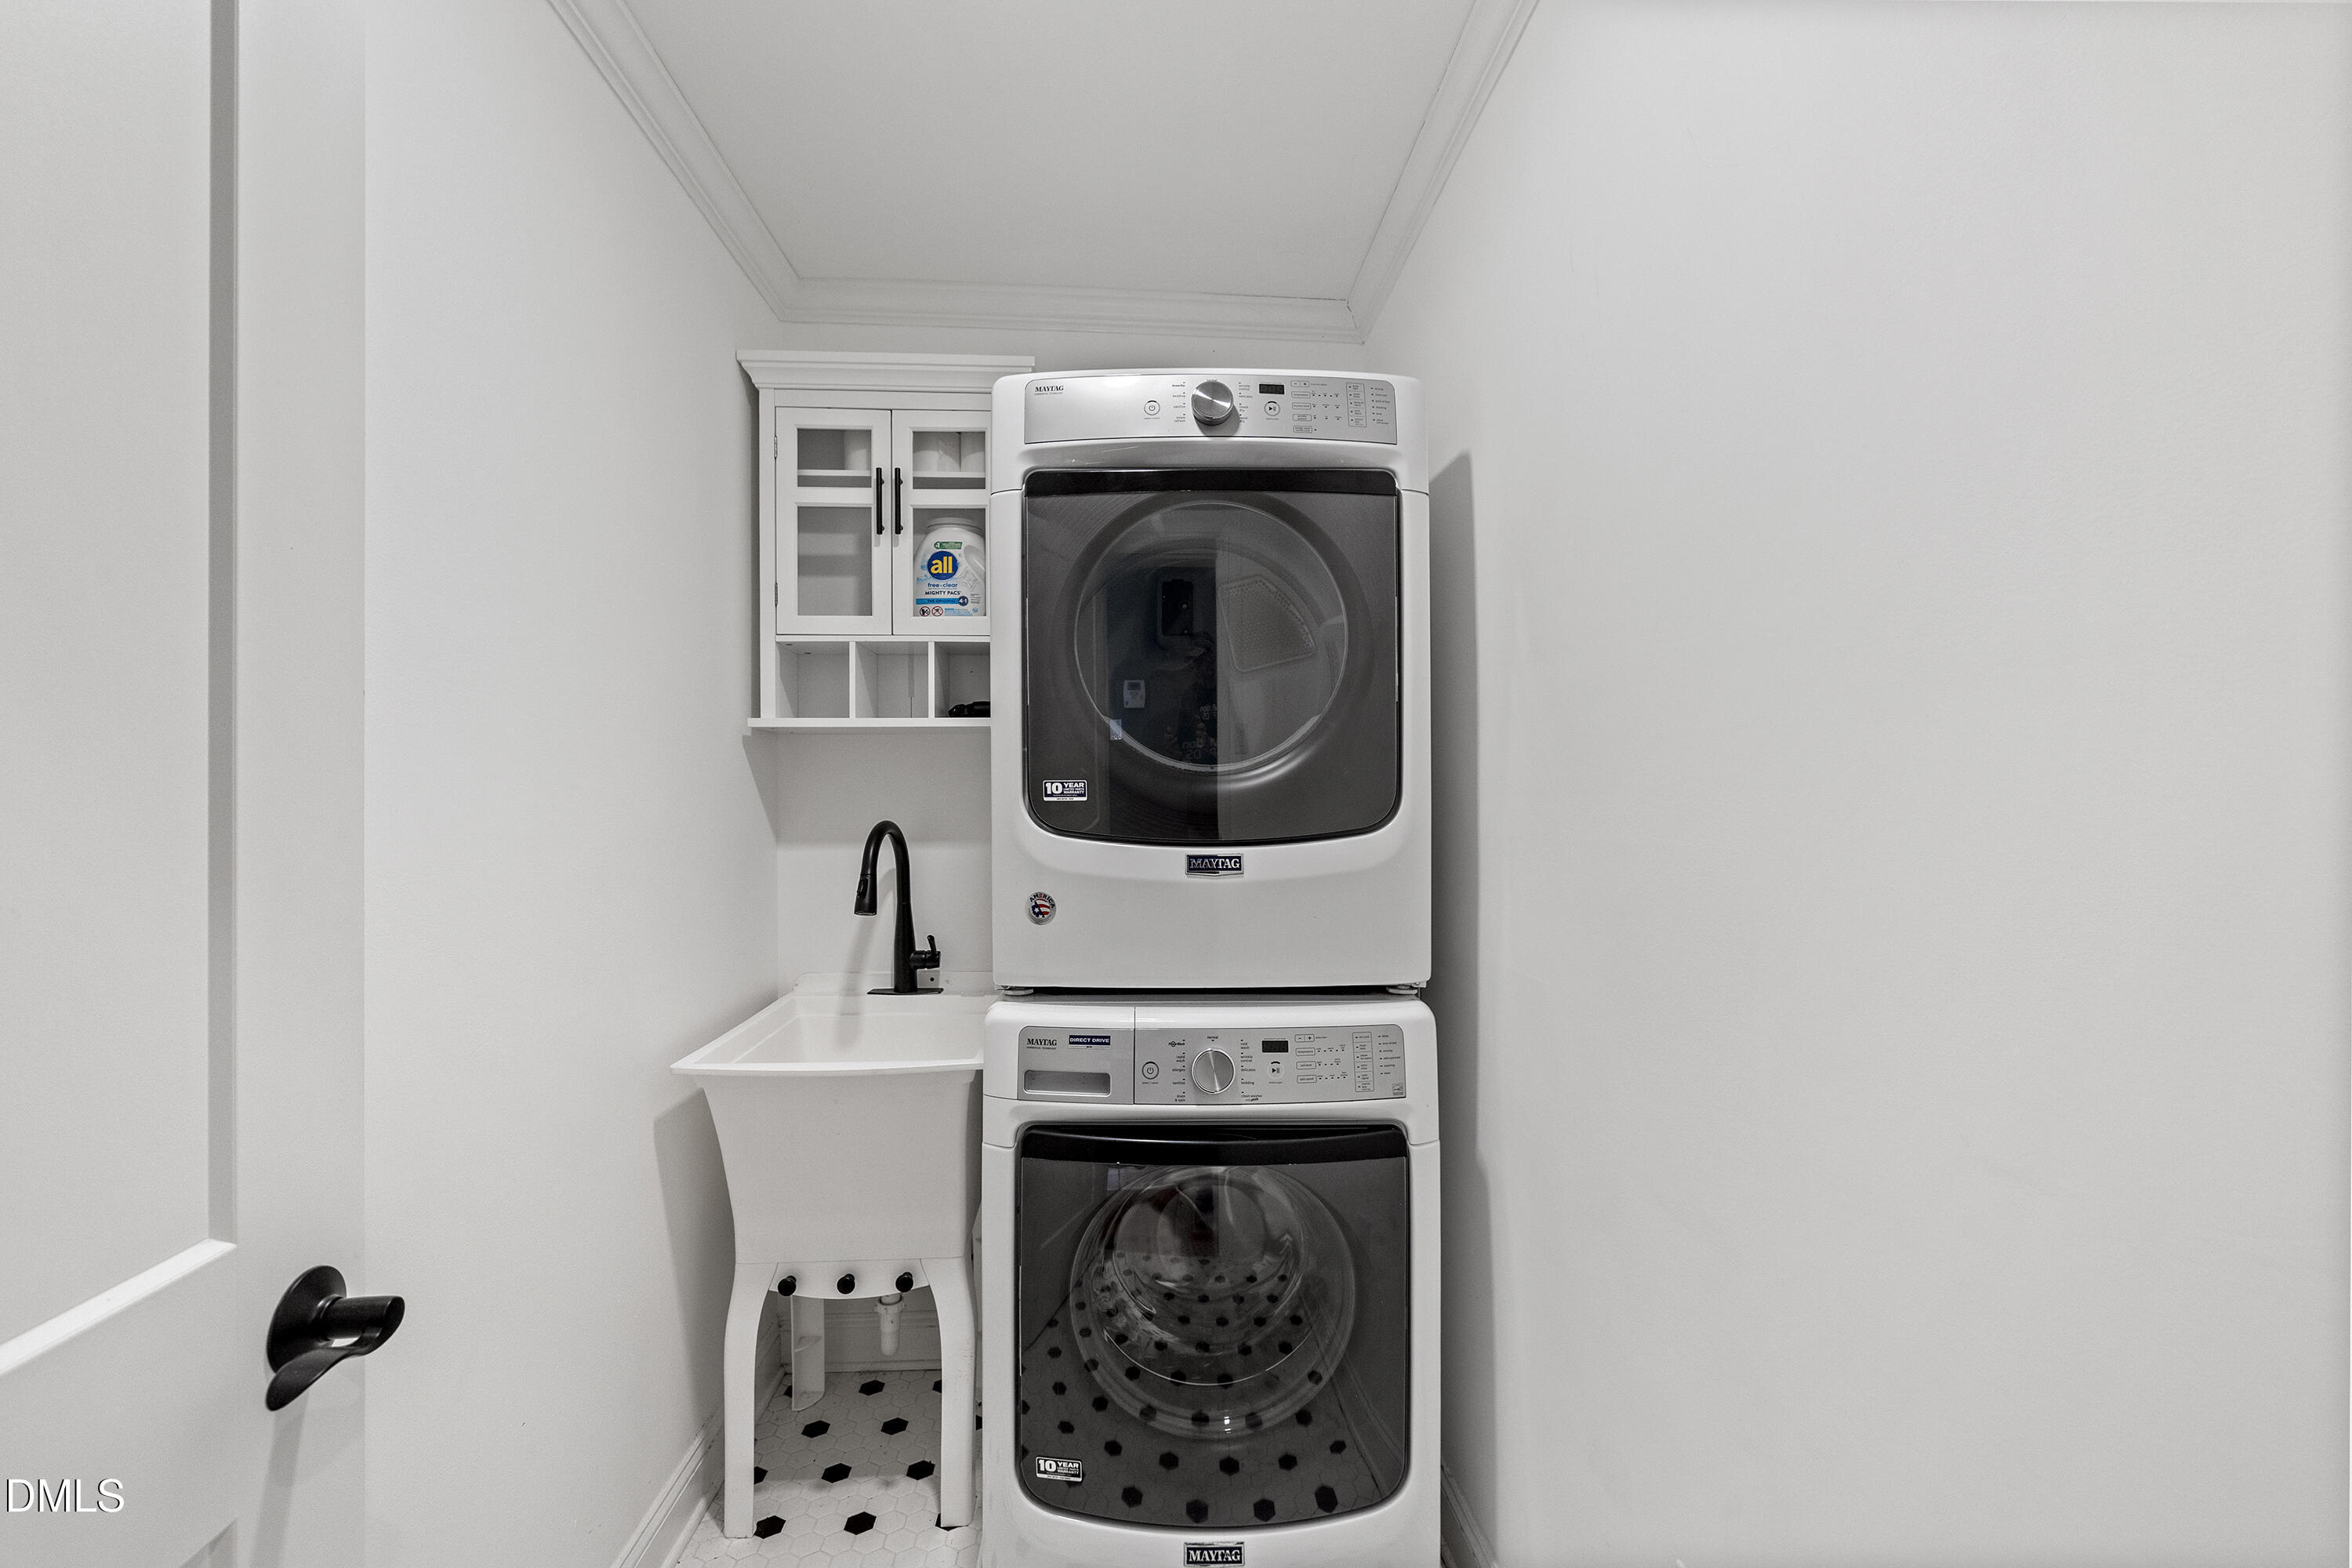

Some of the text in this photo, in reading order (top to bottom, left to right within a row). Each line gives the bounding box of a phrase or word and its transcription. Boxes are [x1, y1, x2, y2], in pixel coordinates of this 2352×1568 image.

[931, 556, 953, 574] all
[1045, 782, 1062, 794] 10
[1189, 858, 1240, 869] MAYTAG
[1029, 893, 1055, 909] AMERICA
[1038, 1459, 1057, 1472] 10
[1188, 1549, 1240, 1562] MAYTAG
